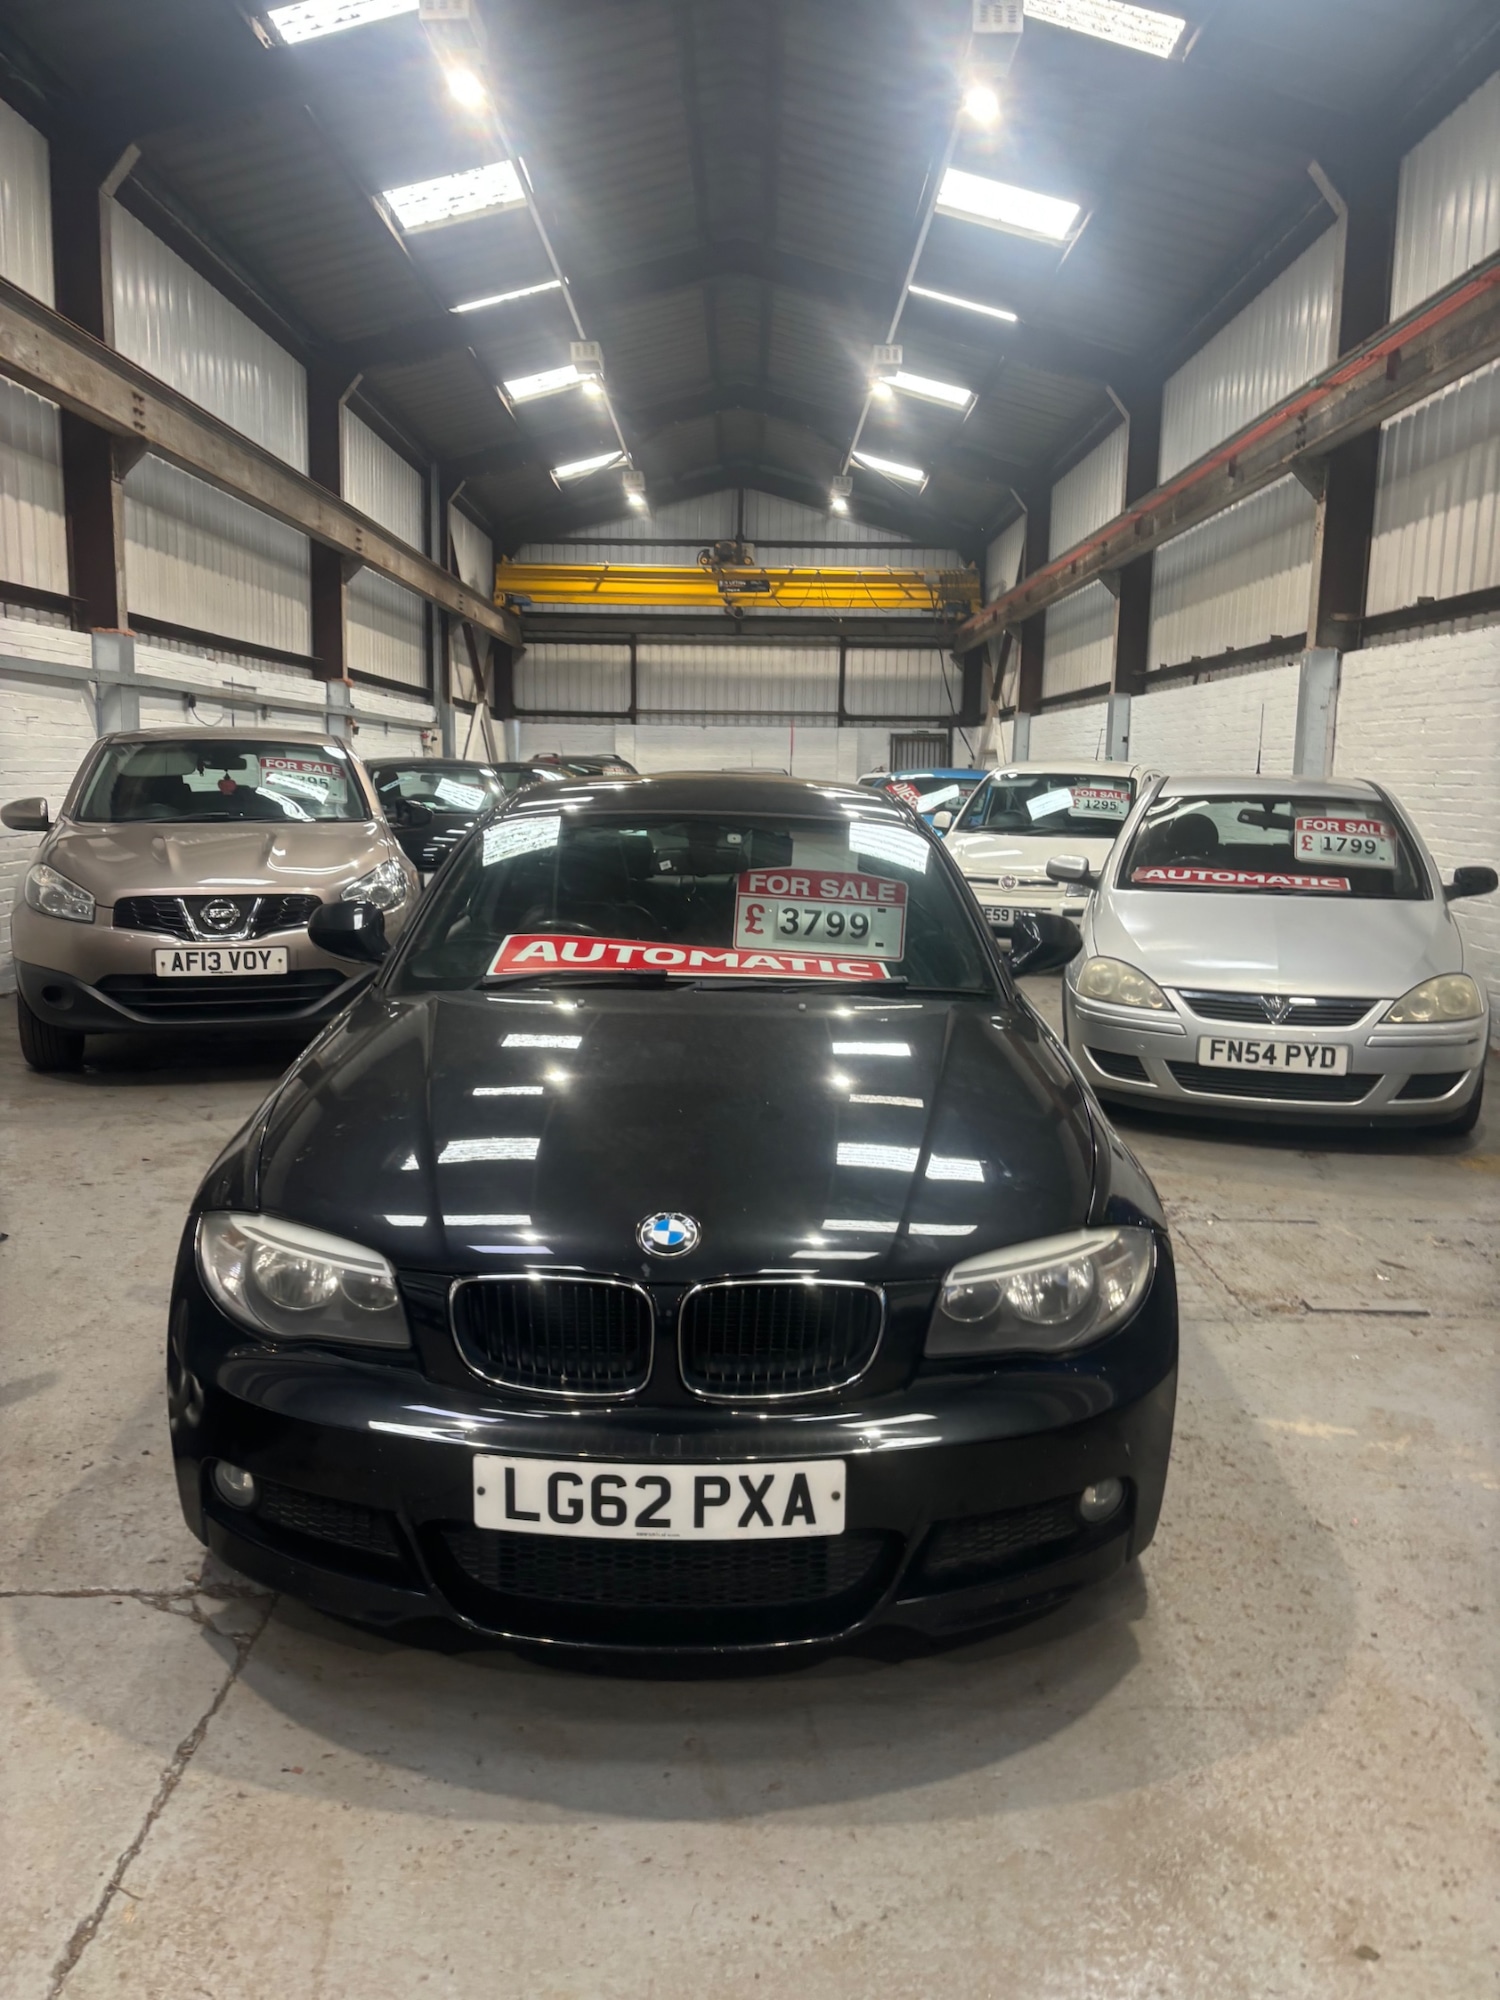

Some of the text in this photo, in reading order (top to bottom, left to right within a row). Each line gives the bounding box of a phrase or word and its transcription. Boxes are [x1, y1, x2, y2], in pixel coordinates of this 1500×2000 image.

[265, 758, 341, 776] FOR SALE
[1074, 789, 1128, 800] FOR SALE
[1084, 800, 1117, 811] 1295
[1302, 819, 1340, 832] FOR
[1322, 836, 1377, 855] 1799
[750, 874, 897, 901] FOR SALE
[1145, 869, 1341, 887] AUTOMATIC
[779, 907, 869, 939] 3799
[984, 908, 1010, 922] E59
[171, 950, 272, 972] AF13 VOY
[511, 940, 874, 977] AUTOMATIC
[1209, 1039, 1337, 1069] FN54 PYD
[504, 1466, 817, 1529] LG62 PXA
